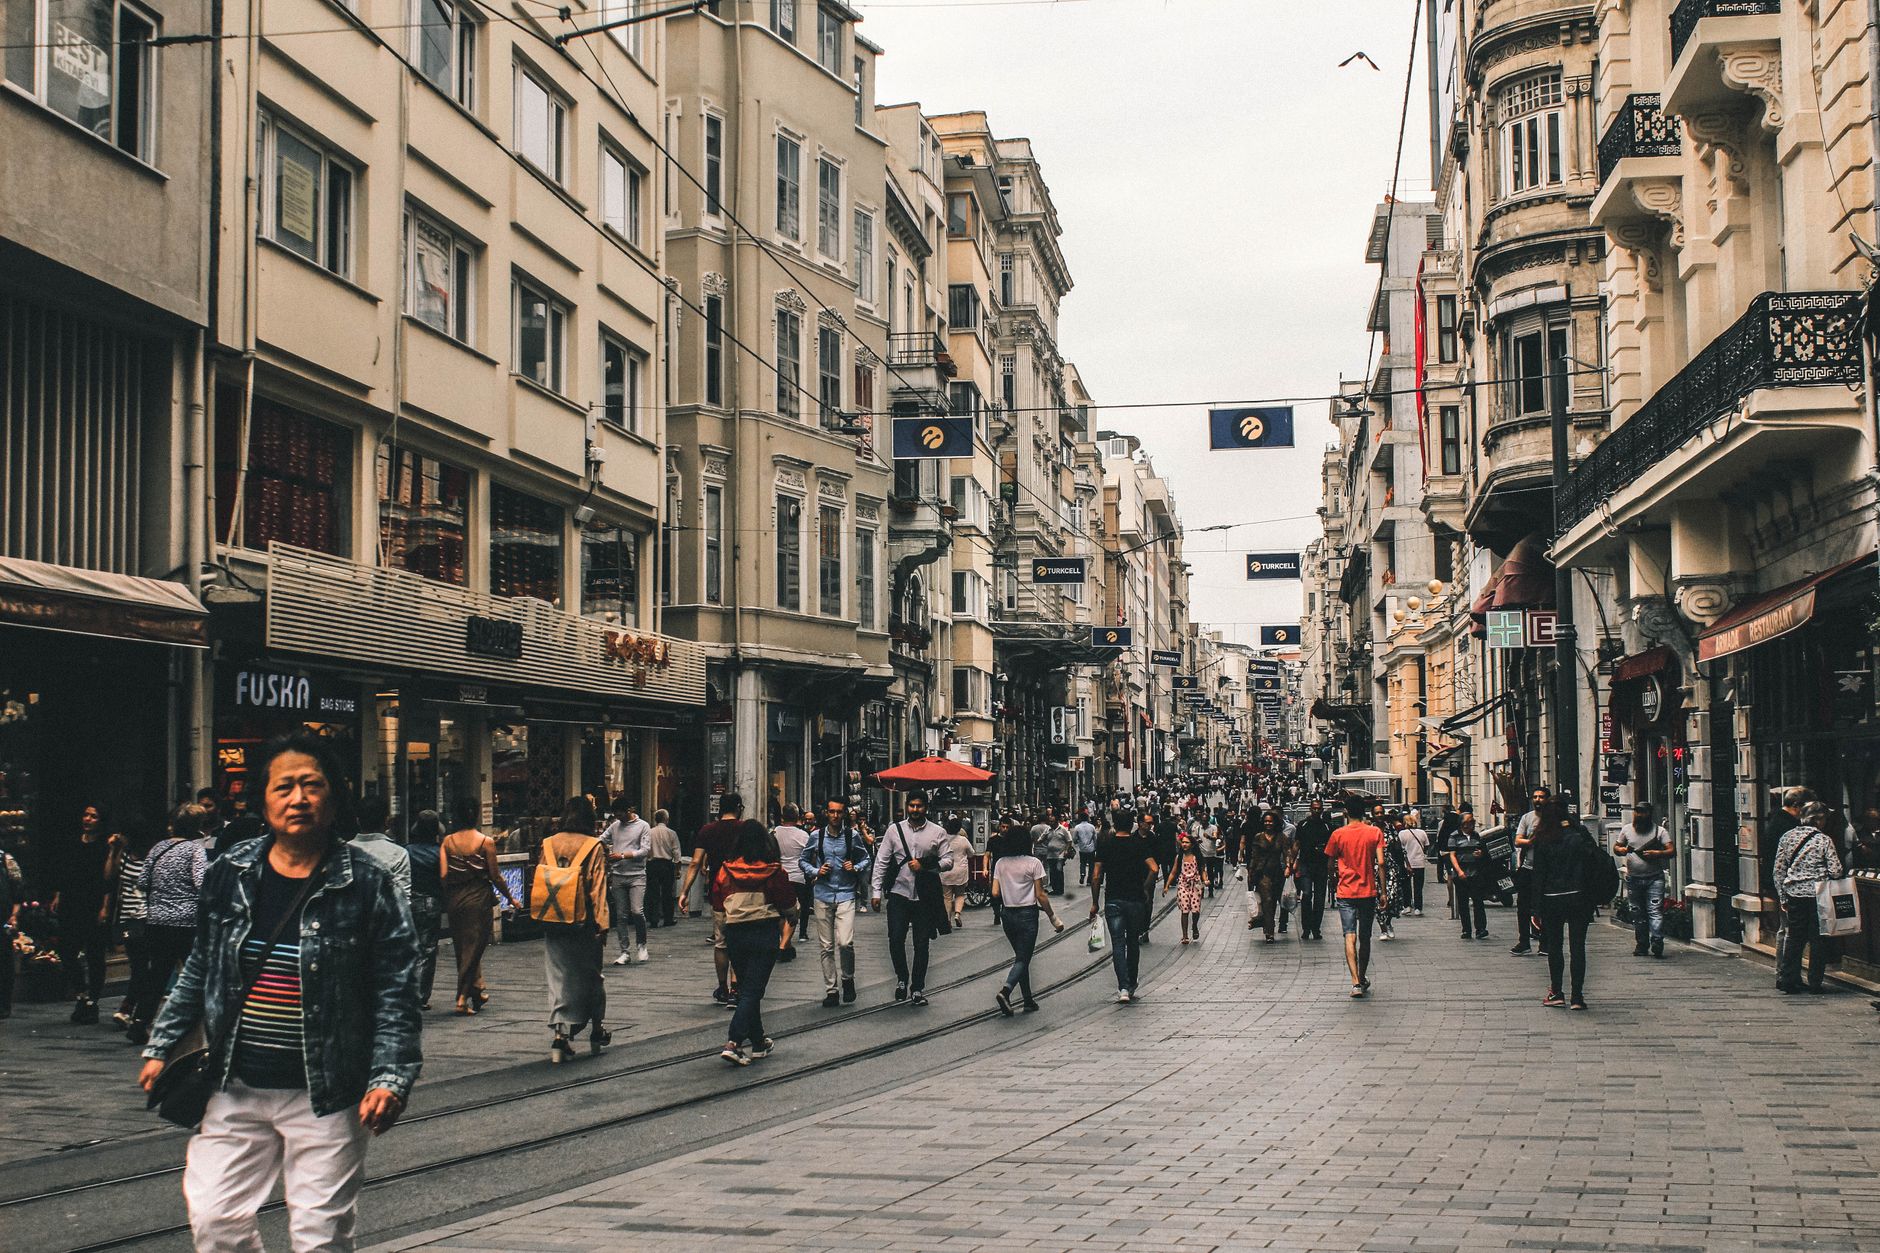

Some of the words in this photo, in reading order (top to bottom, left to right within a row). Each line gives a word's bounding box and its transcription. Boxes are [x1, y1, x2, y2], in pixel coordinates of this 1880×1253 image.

[55, 24, 102, 71] BEST
[1047, 567, 1082, 575] TURKCELL
[1261, 562, 1296, 570] TURKCELL
[1748, 604, 1794, 643] RESTAURANT
[236, 671, 310, 709] FUSKA
[320, 697, 334, 710] BAG
[335, 699, 355, 712] STORE
